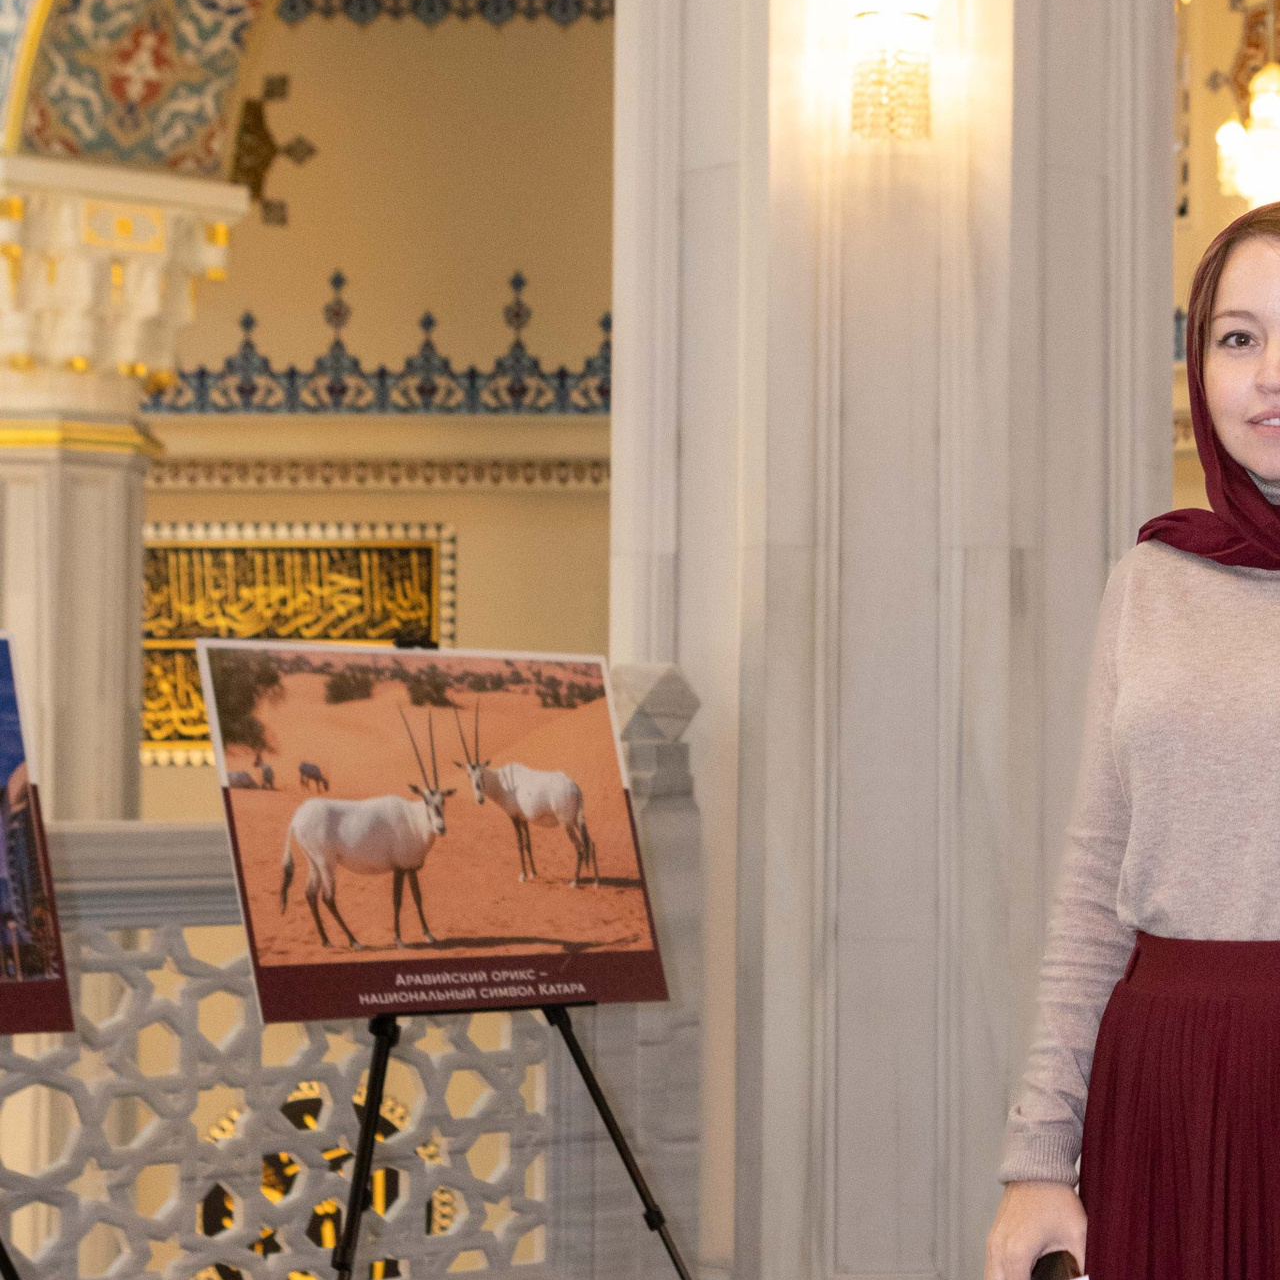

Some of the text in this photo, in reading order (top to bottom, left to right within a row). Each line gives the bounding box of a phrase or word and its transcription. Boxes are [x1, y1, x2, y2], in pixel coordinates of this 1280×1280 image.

[395, 970, 488, 986] АРАВИЙСКИЙ
[491, 968, 536, 981] ОРИКС
[358, 982, 586, 1005] НАЦИОНАЛЬНЫЙ СИМВОЛ КАТАРА
